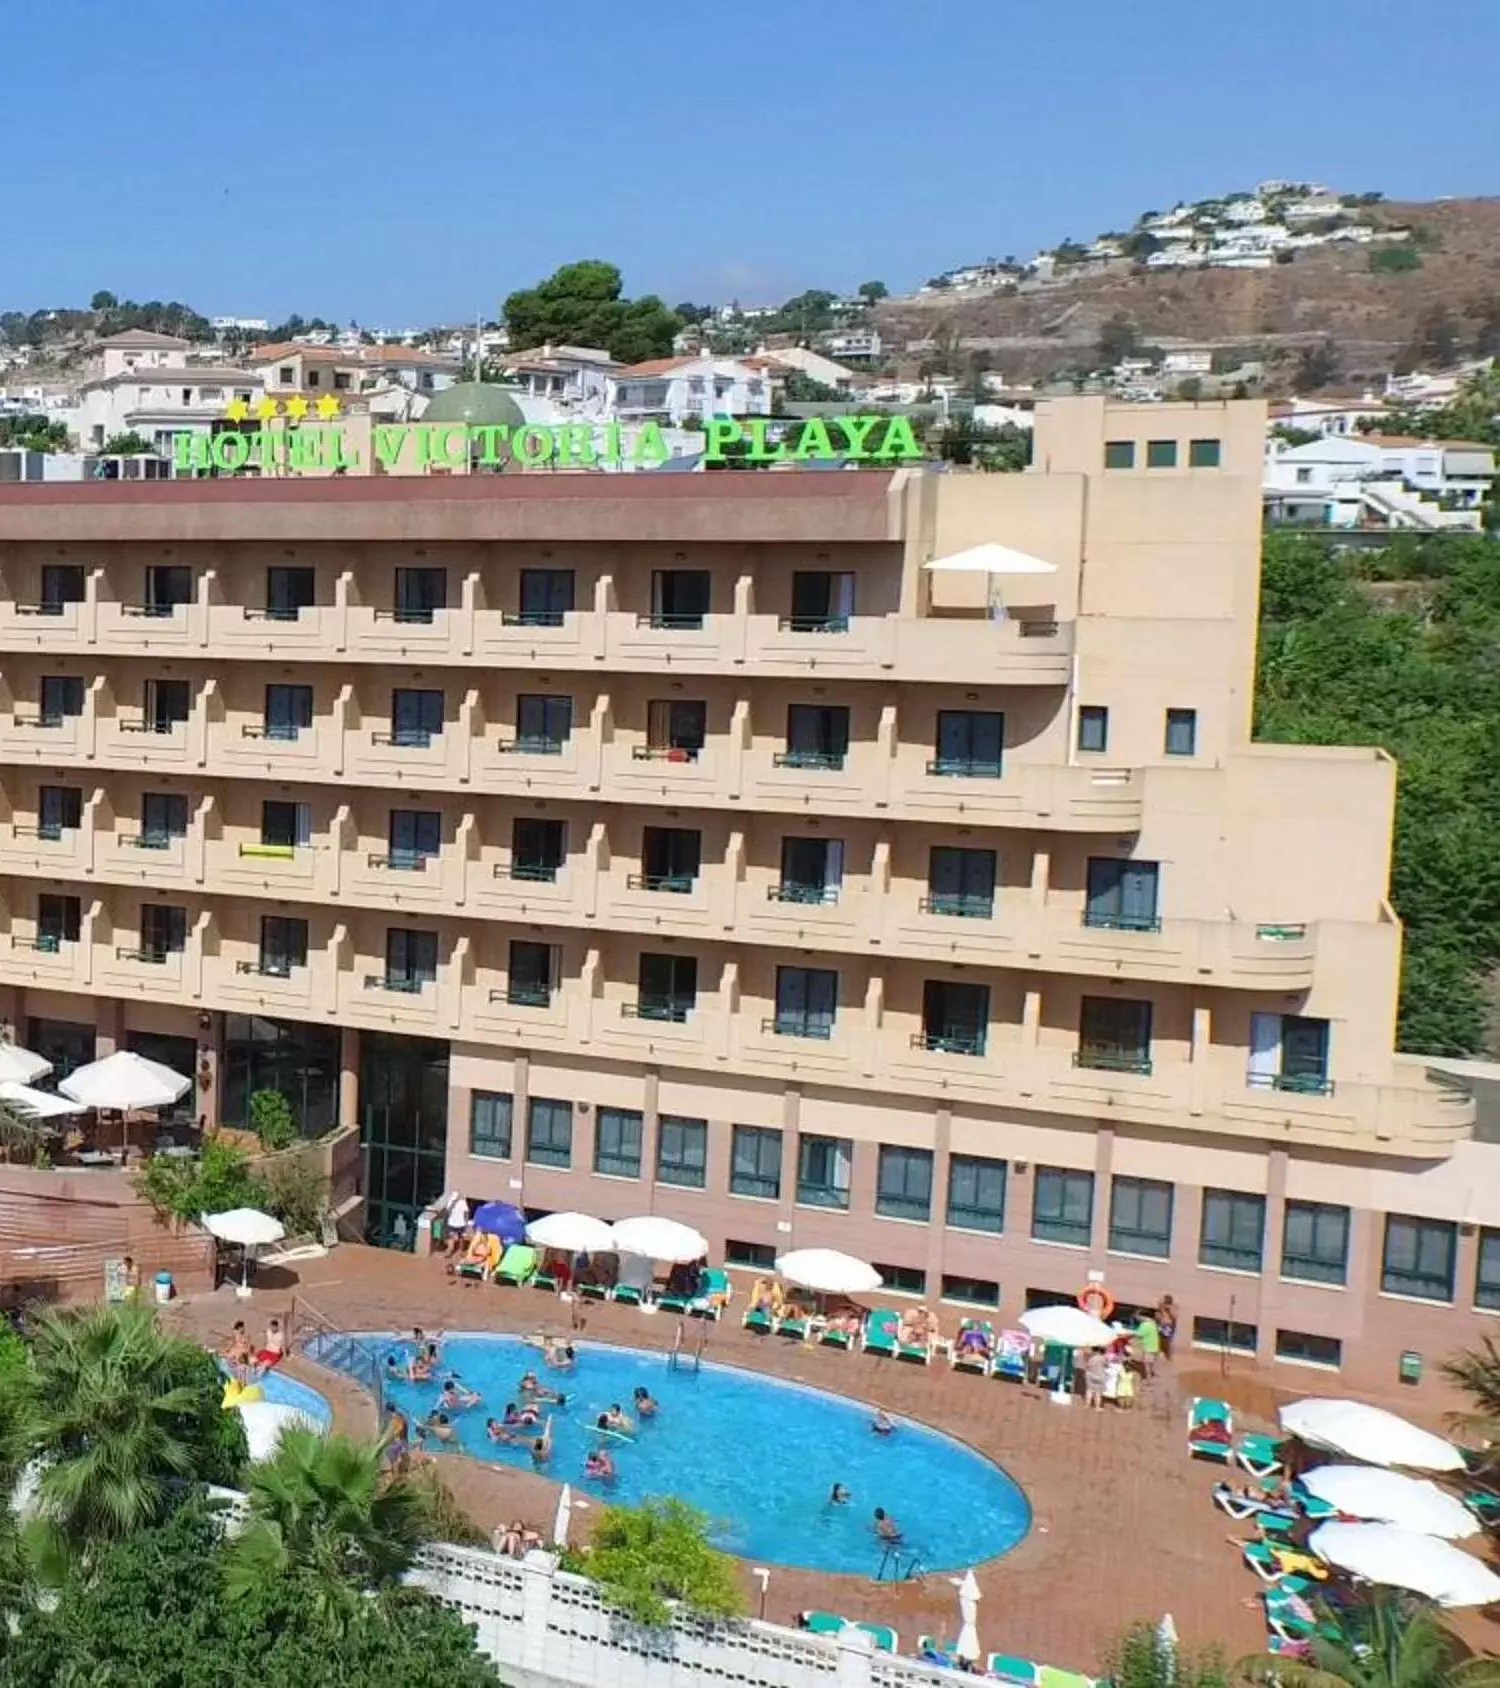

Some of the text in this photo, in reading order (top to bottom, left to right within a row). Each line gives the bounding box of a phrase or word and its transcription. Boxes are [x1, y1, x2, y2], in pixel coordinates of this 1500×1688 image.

[172, 416, 924, 470] HOTEL VICTORIA PLAYA
